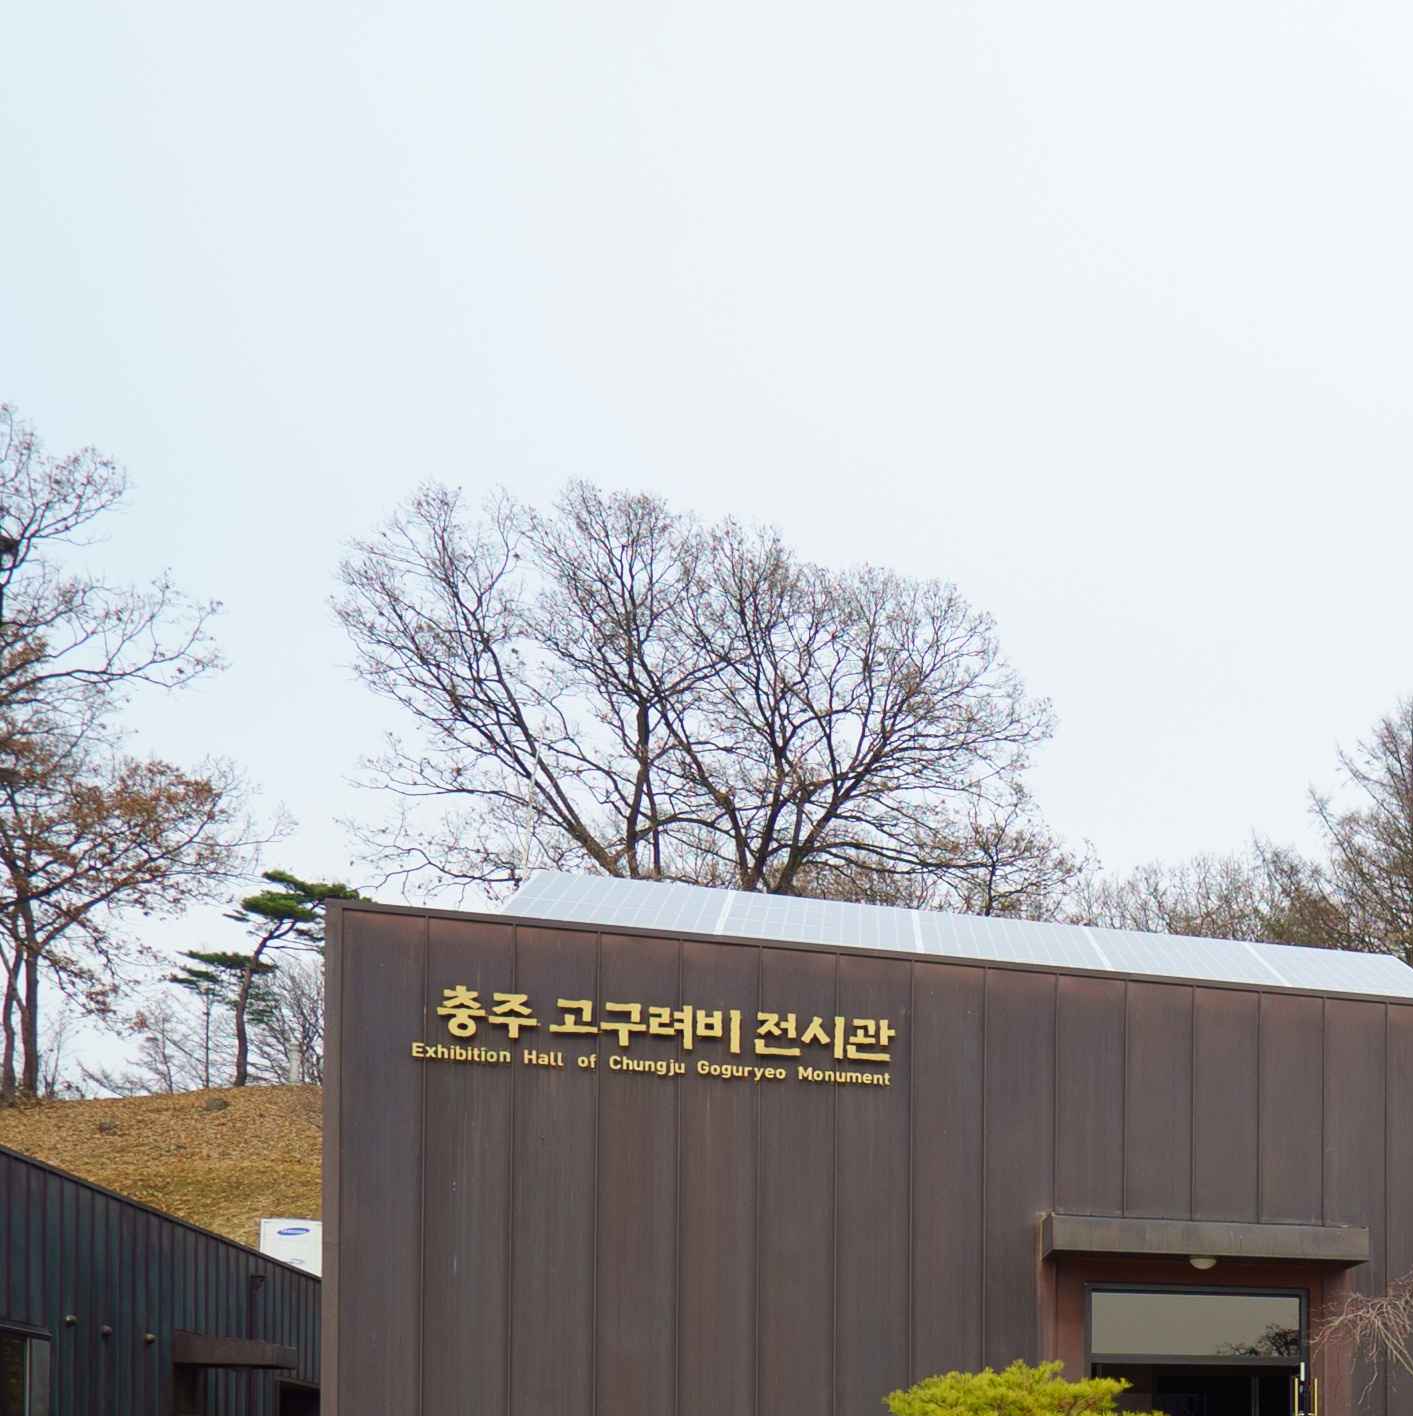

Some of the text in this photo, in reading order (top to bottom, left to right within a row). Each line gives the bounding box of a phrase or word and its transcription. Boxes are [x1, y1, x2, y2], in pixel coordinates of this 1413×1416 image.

[437, 984, 897, 1062] 충주 고구려비 전시관
[411, 1041, 891, 1086] Exhibition Hall of Chungju Goguryeo Monument
